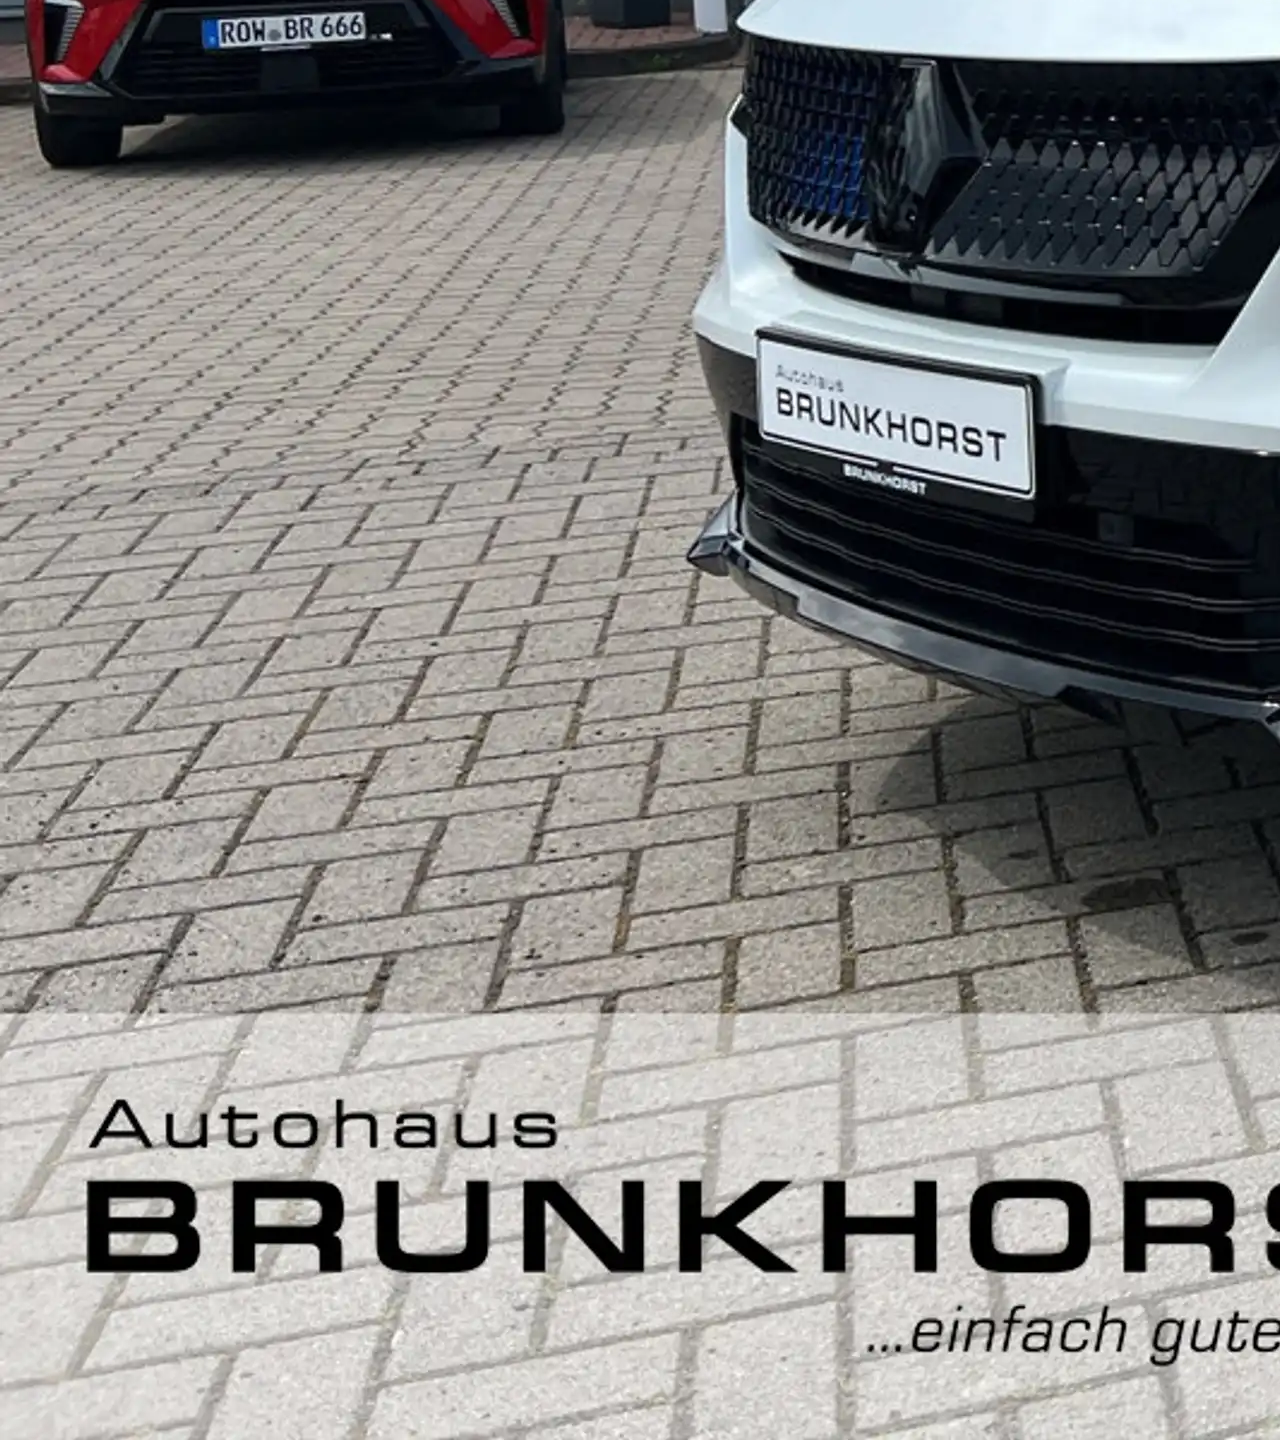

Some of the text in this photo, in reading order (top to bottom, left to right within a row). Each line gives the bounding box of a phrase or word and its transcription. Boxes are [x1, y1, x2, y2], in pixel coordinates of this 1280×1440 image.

[221, 20, 266, 44] ROW
[284, 17, 313, 40] BR
[321, 15, 362, 37] 666
[775, 364, 845, 393] Autohaus
[776, 387, 1007, 462] BRUNKHORST
